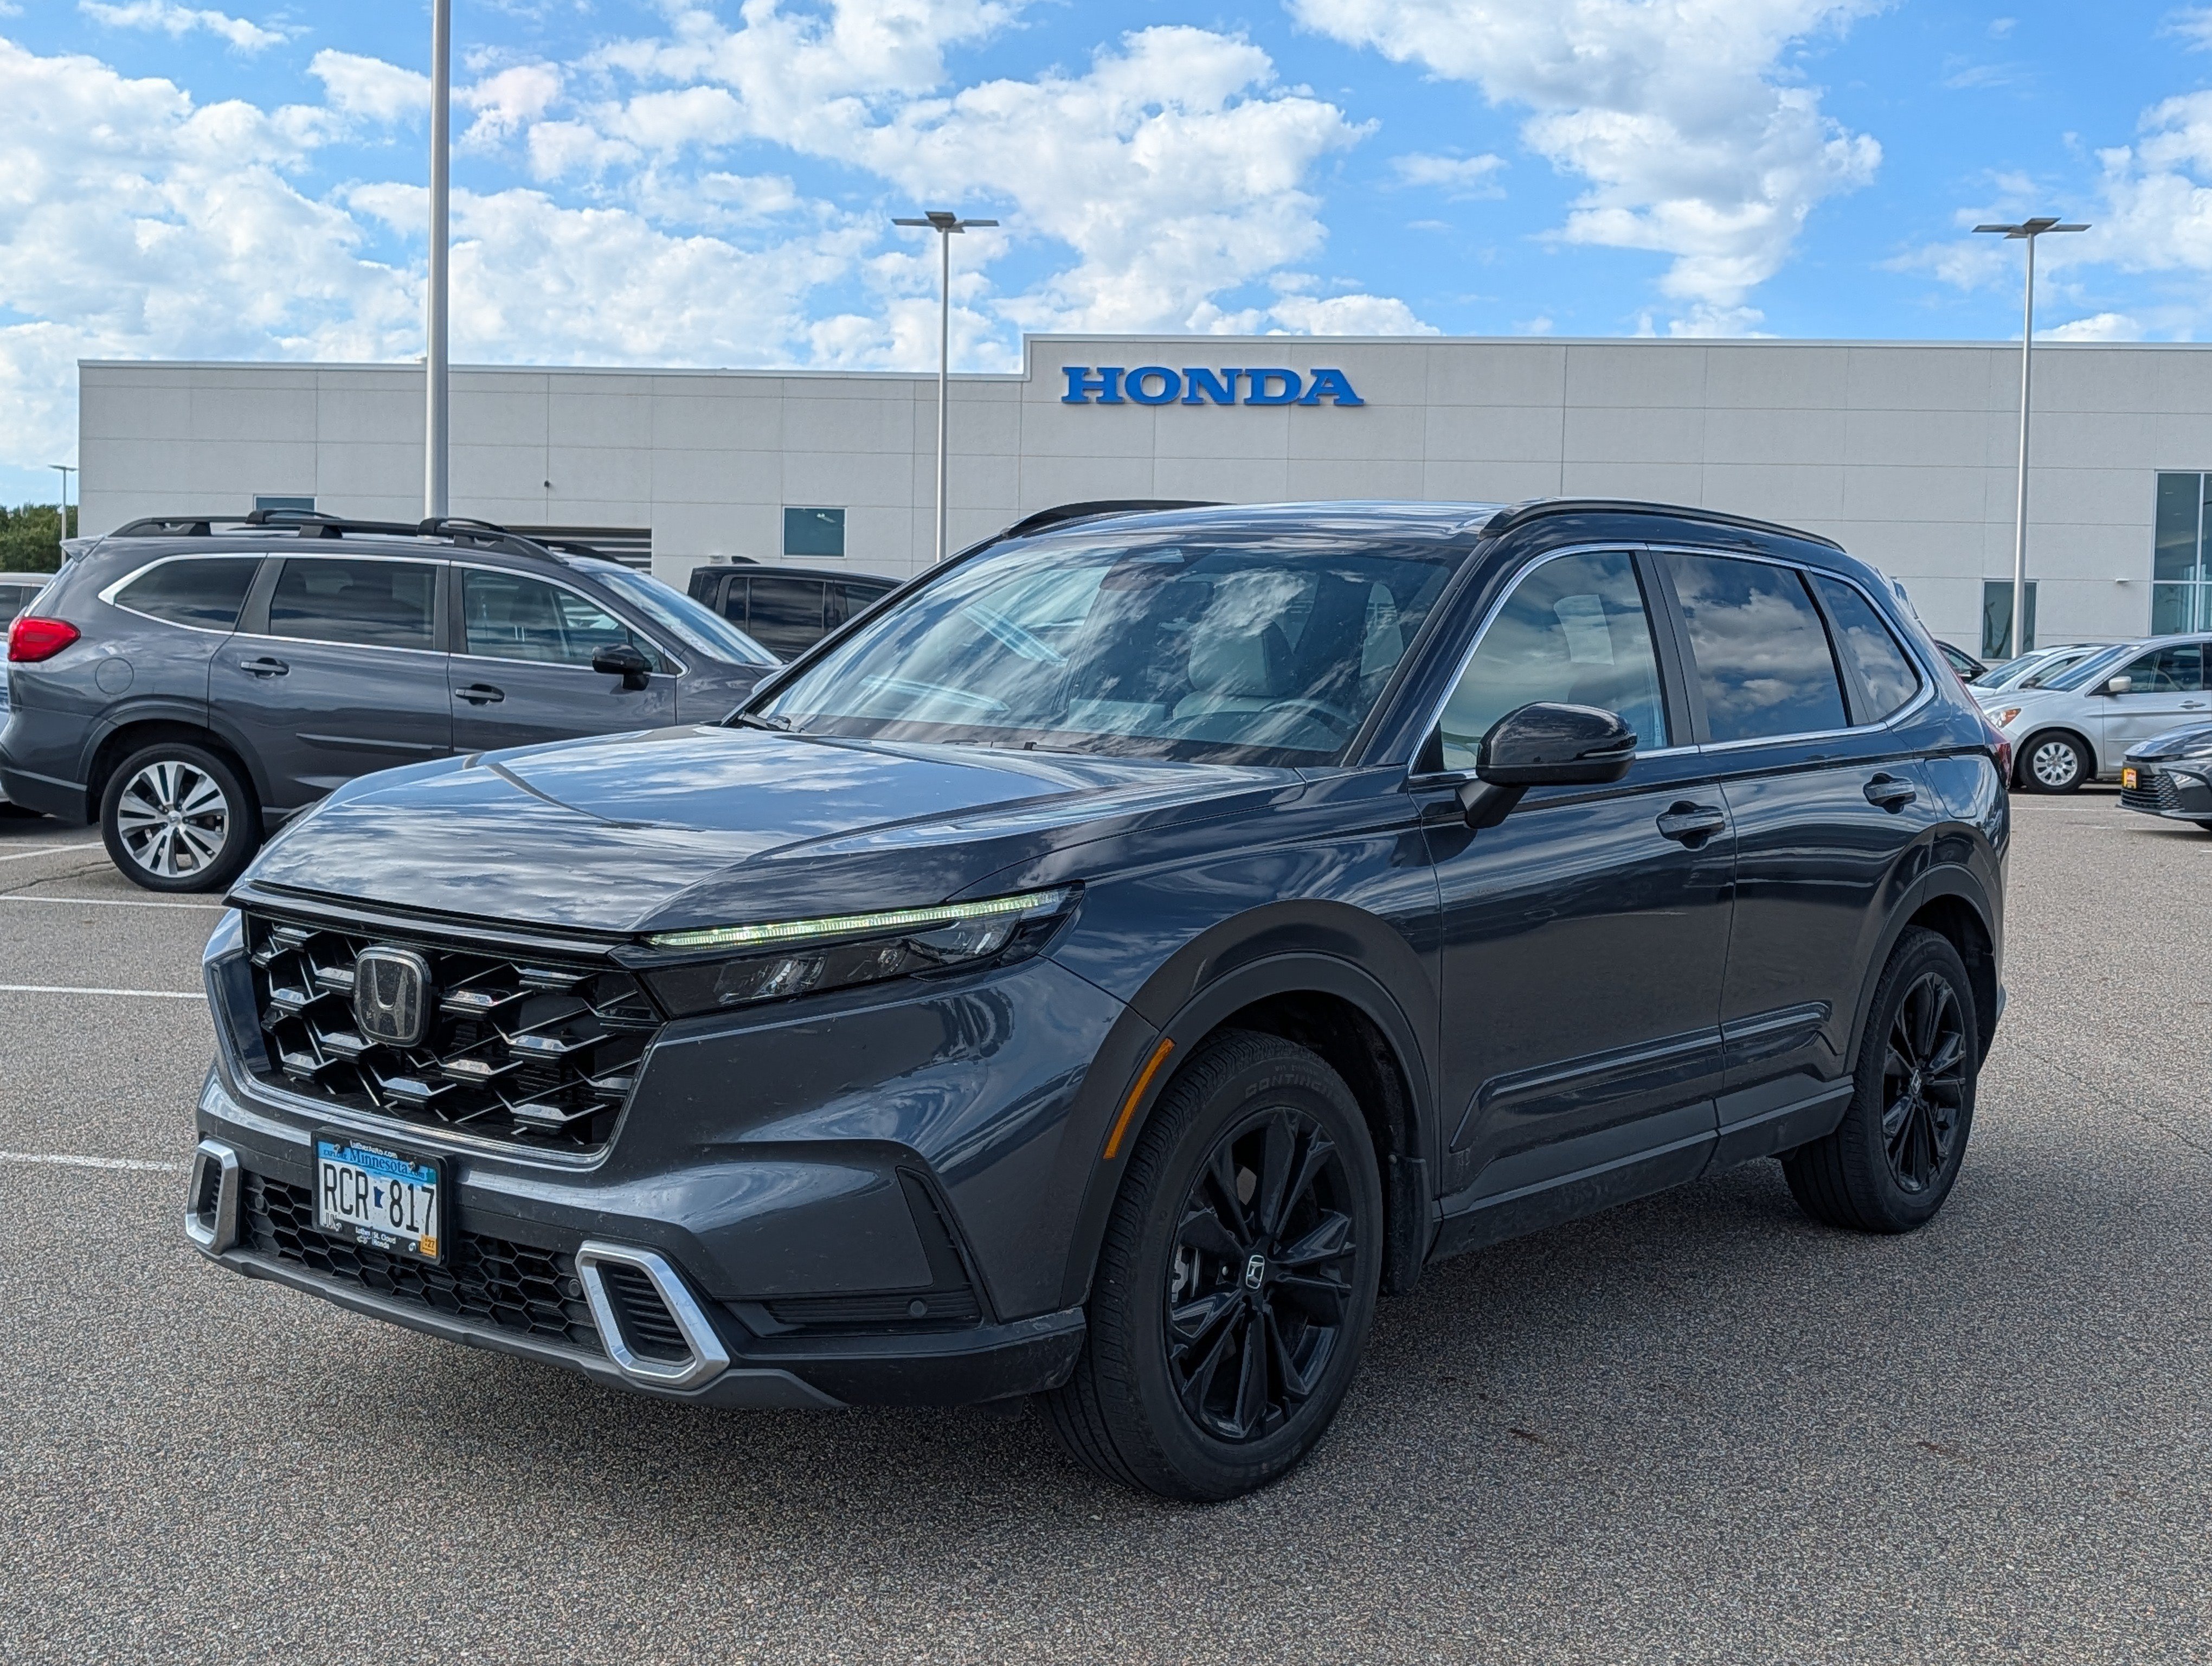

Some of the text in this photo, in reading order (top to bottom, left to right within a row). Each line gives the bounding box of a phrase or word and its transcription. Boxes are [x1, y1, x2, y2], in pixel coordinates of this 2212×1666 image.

[1061, 366, 1365, 406] HONDA
[324, 1163, 435, 1235] RCR 817
